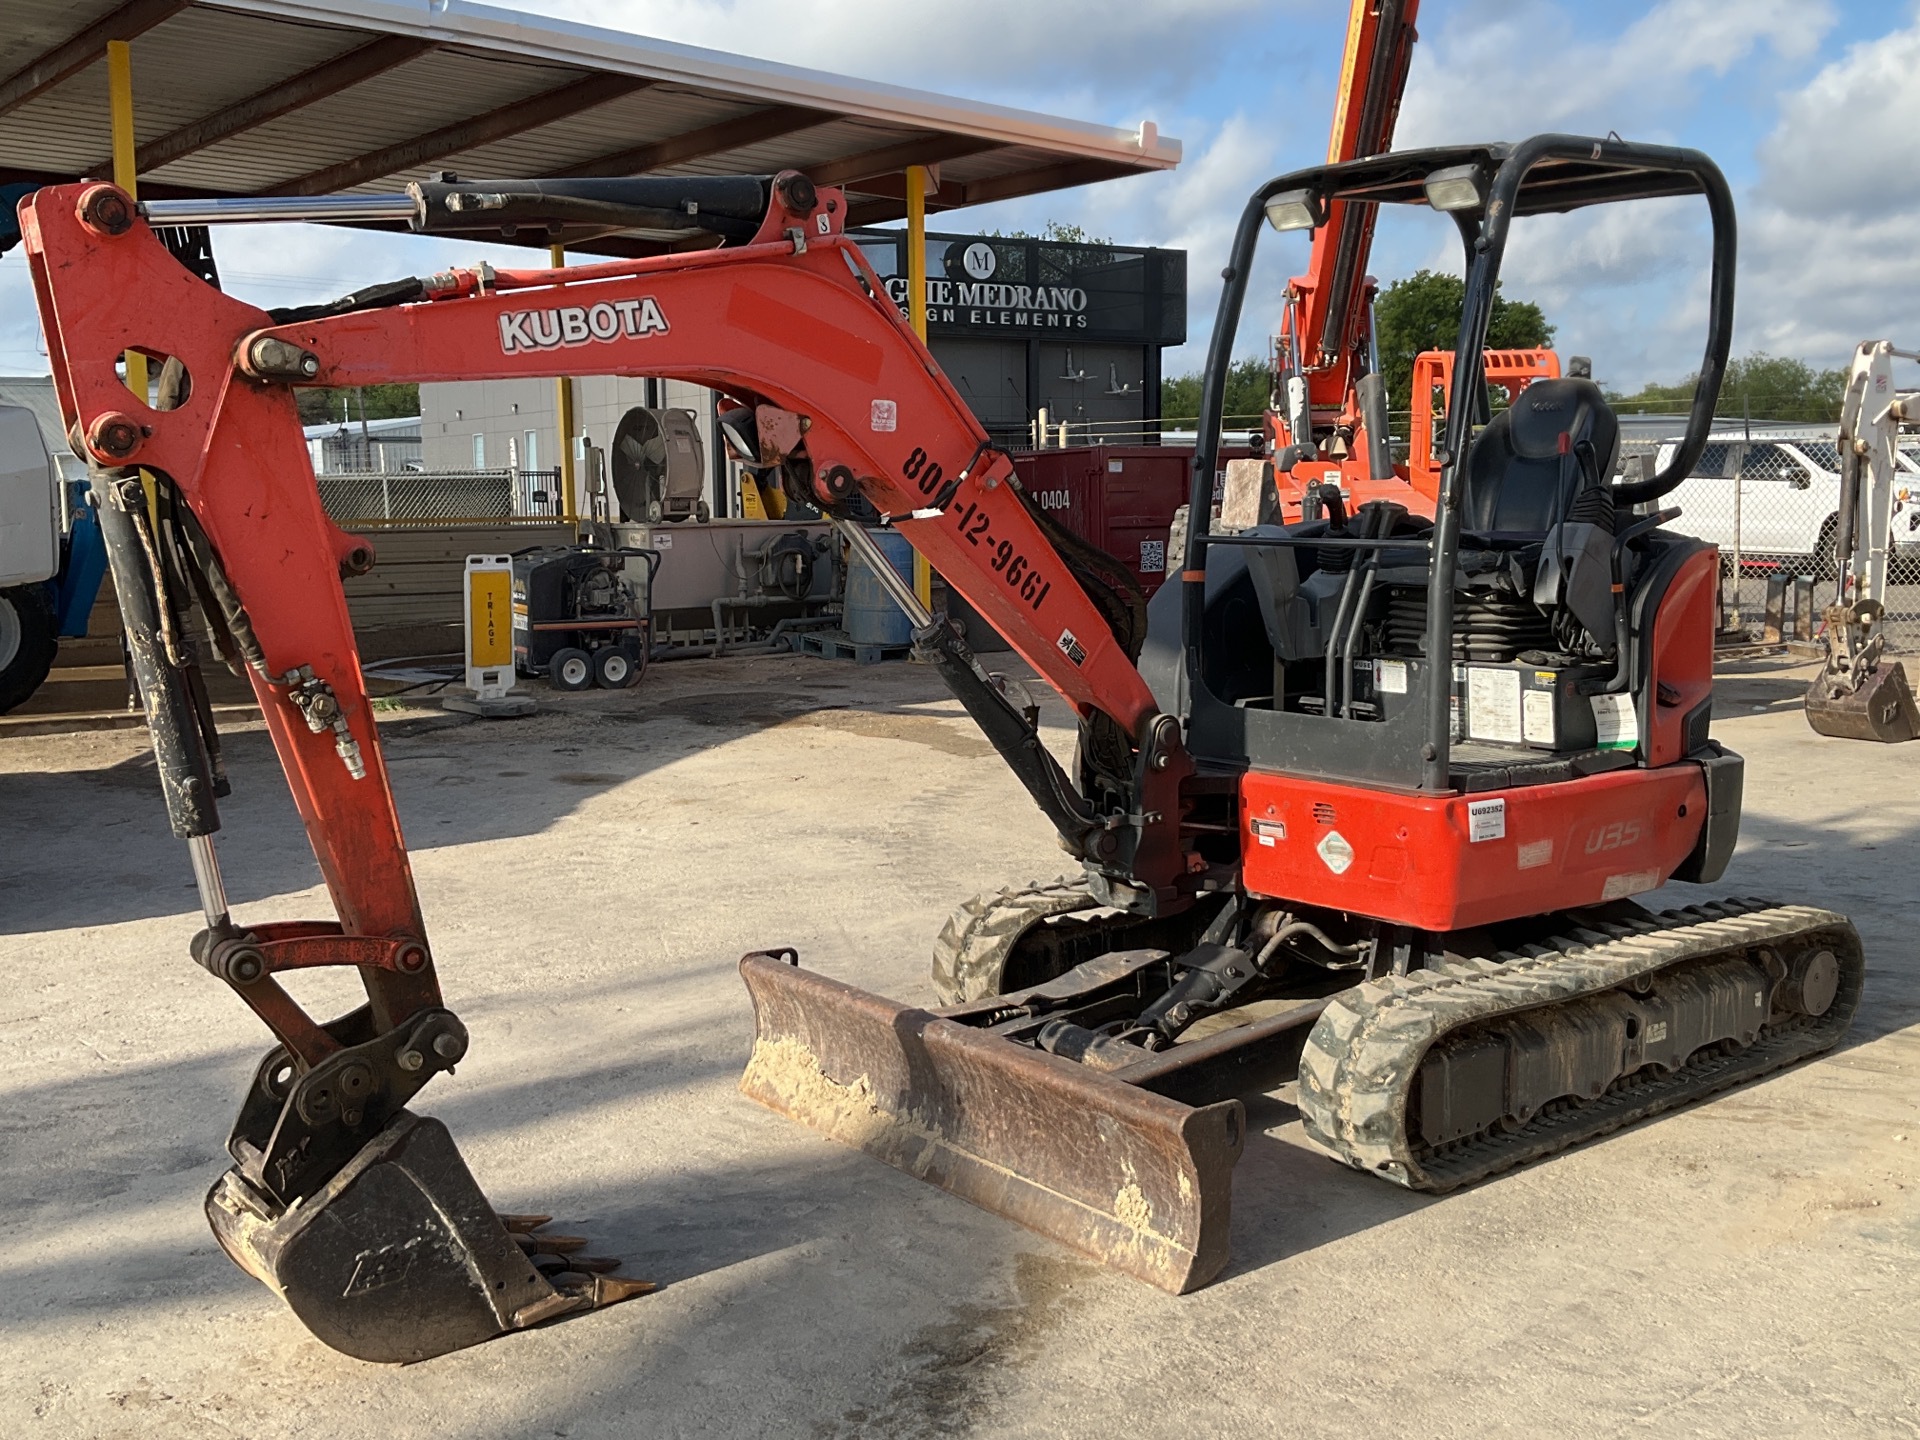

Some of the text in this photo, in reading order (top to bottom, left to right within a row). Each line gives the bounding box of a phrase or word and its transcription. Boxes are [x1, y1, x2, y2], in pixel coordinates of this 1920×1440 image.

[885, 278, 1088, 312] GIE MEDRANO
[499, 298, 668, 351] KUBOTA
[900, 307, 1087, 328] SGN ELEMENTS
[1041, 490, 1070, 510] 0404
[486, 592, 495, 647] TRIAGE
